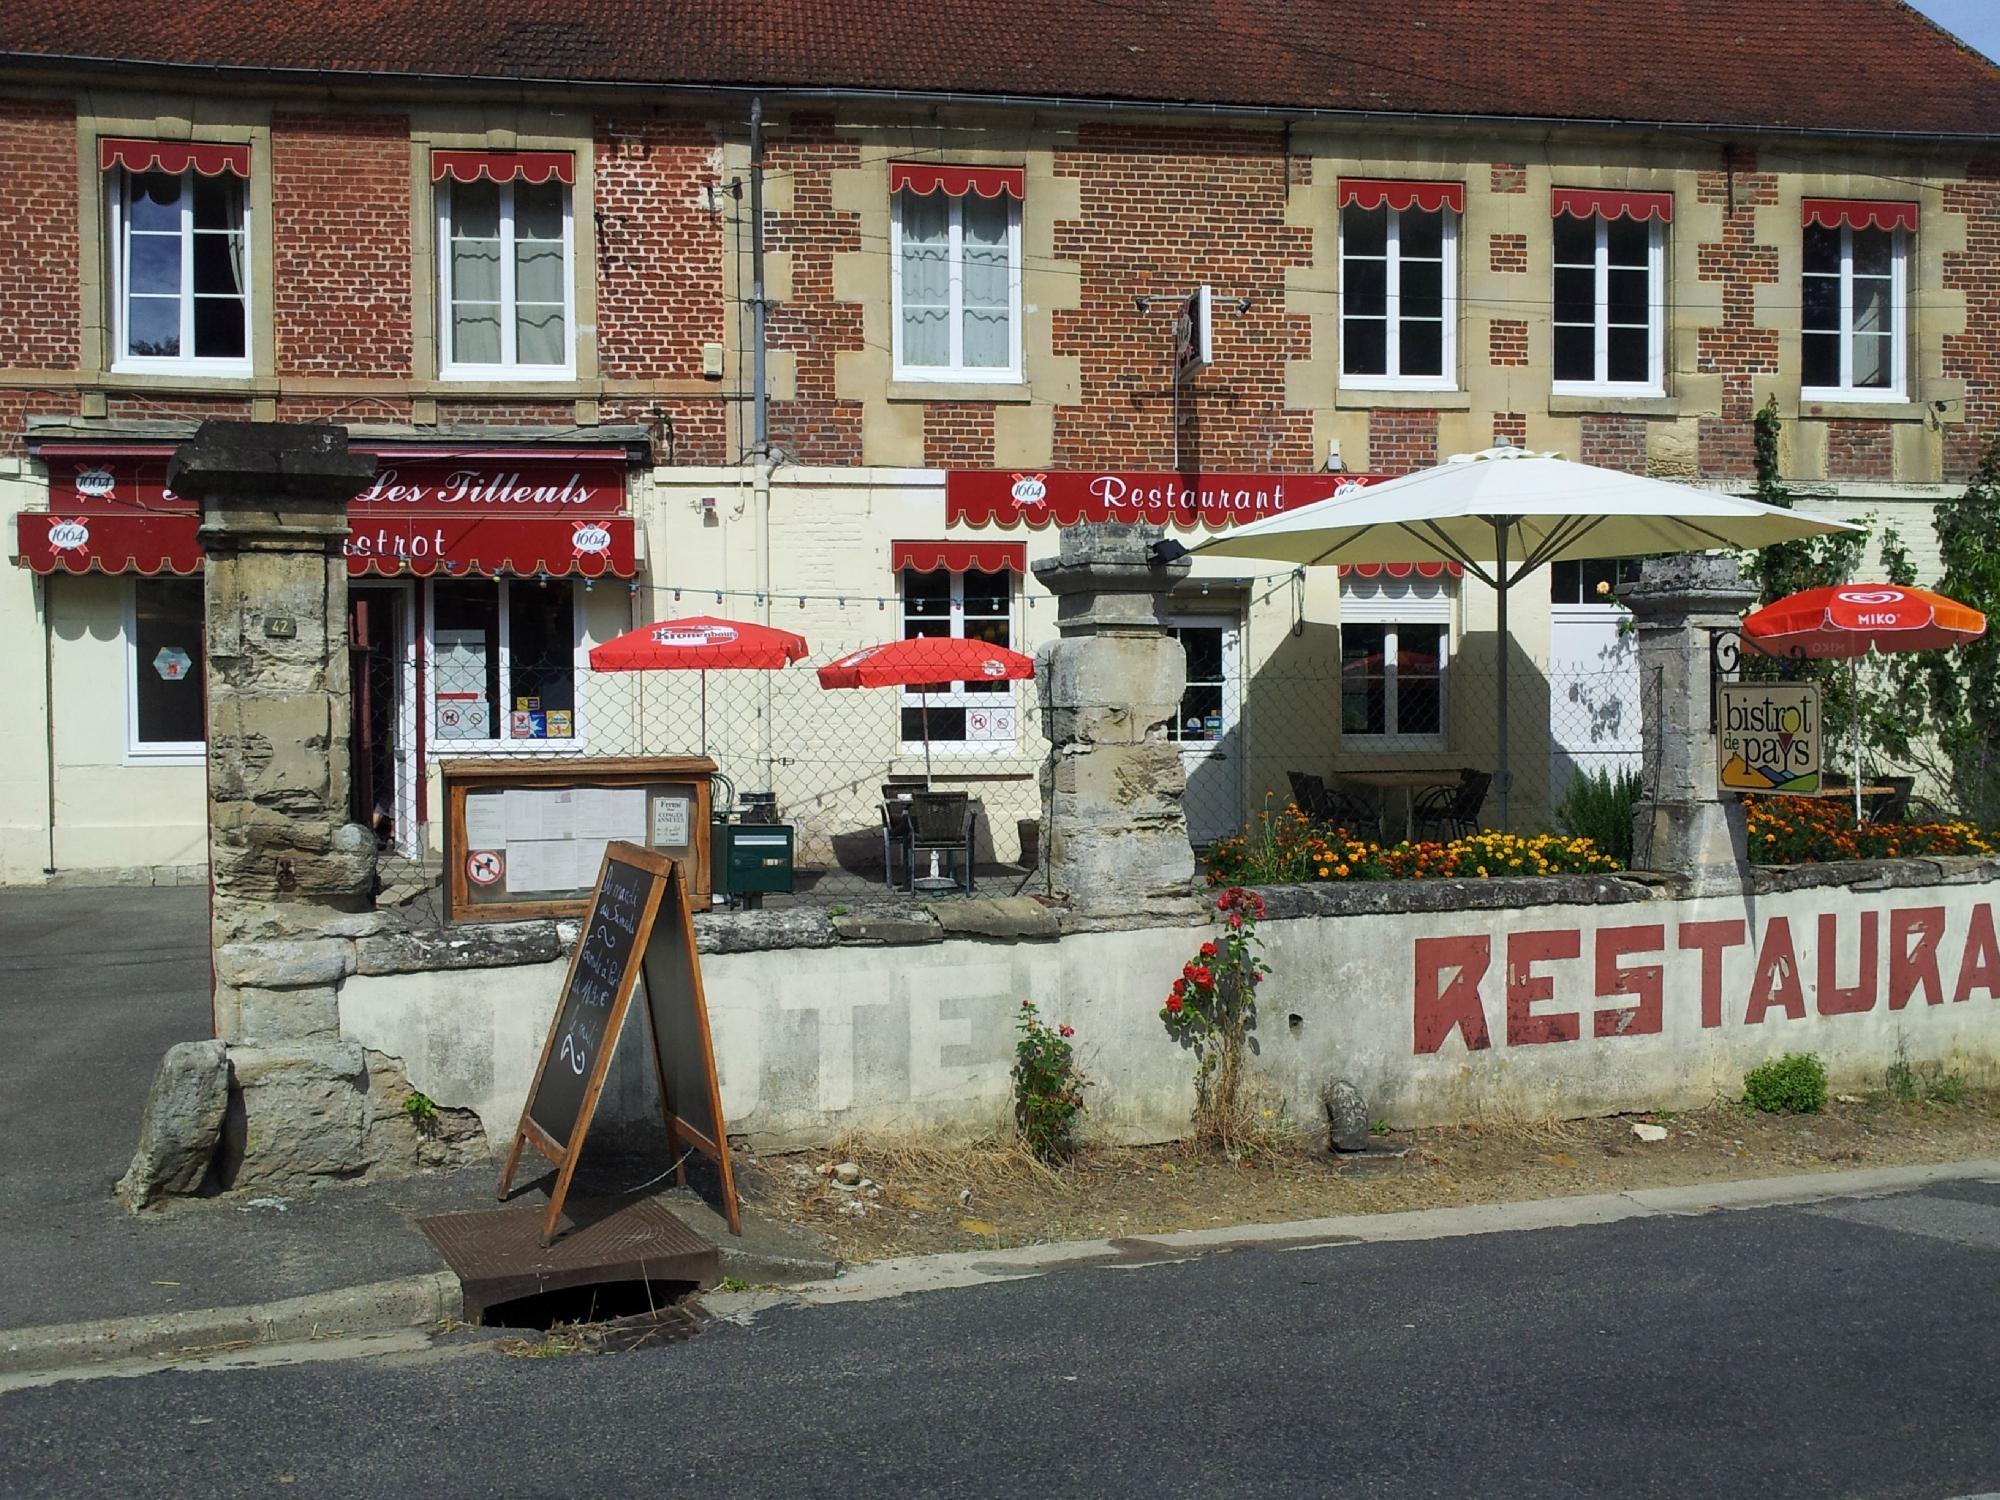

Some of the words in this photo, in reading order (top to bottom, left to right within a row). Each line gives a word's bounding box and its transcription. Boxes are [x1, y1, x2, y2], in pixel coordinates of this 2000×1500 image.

[355, 469, 432, 502] Les
[437, 470, 598, 504] Tilleuls
[1014, 483, 1043, 497] 1664
[1090, 476, 1285, 508] Restaurant
[52, 526, 86, 542] 1664
[343, 529, 446, 557] istrot
[575, 532, 608, 546] 1664
[272, 619, 289, 633] 42
[1858, 613, 1897, 626] MIKO
[1724, 693, 1813, 735] bistrot
[1723, 732, 1740, 751] de
[1742, 737, 1811, 776] pays
